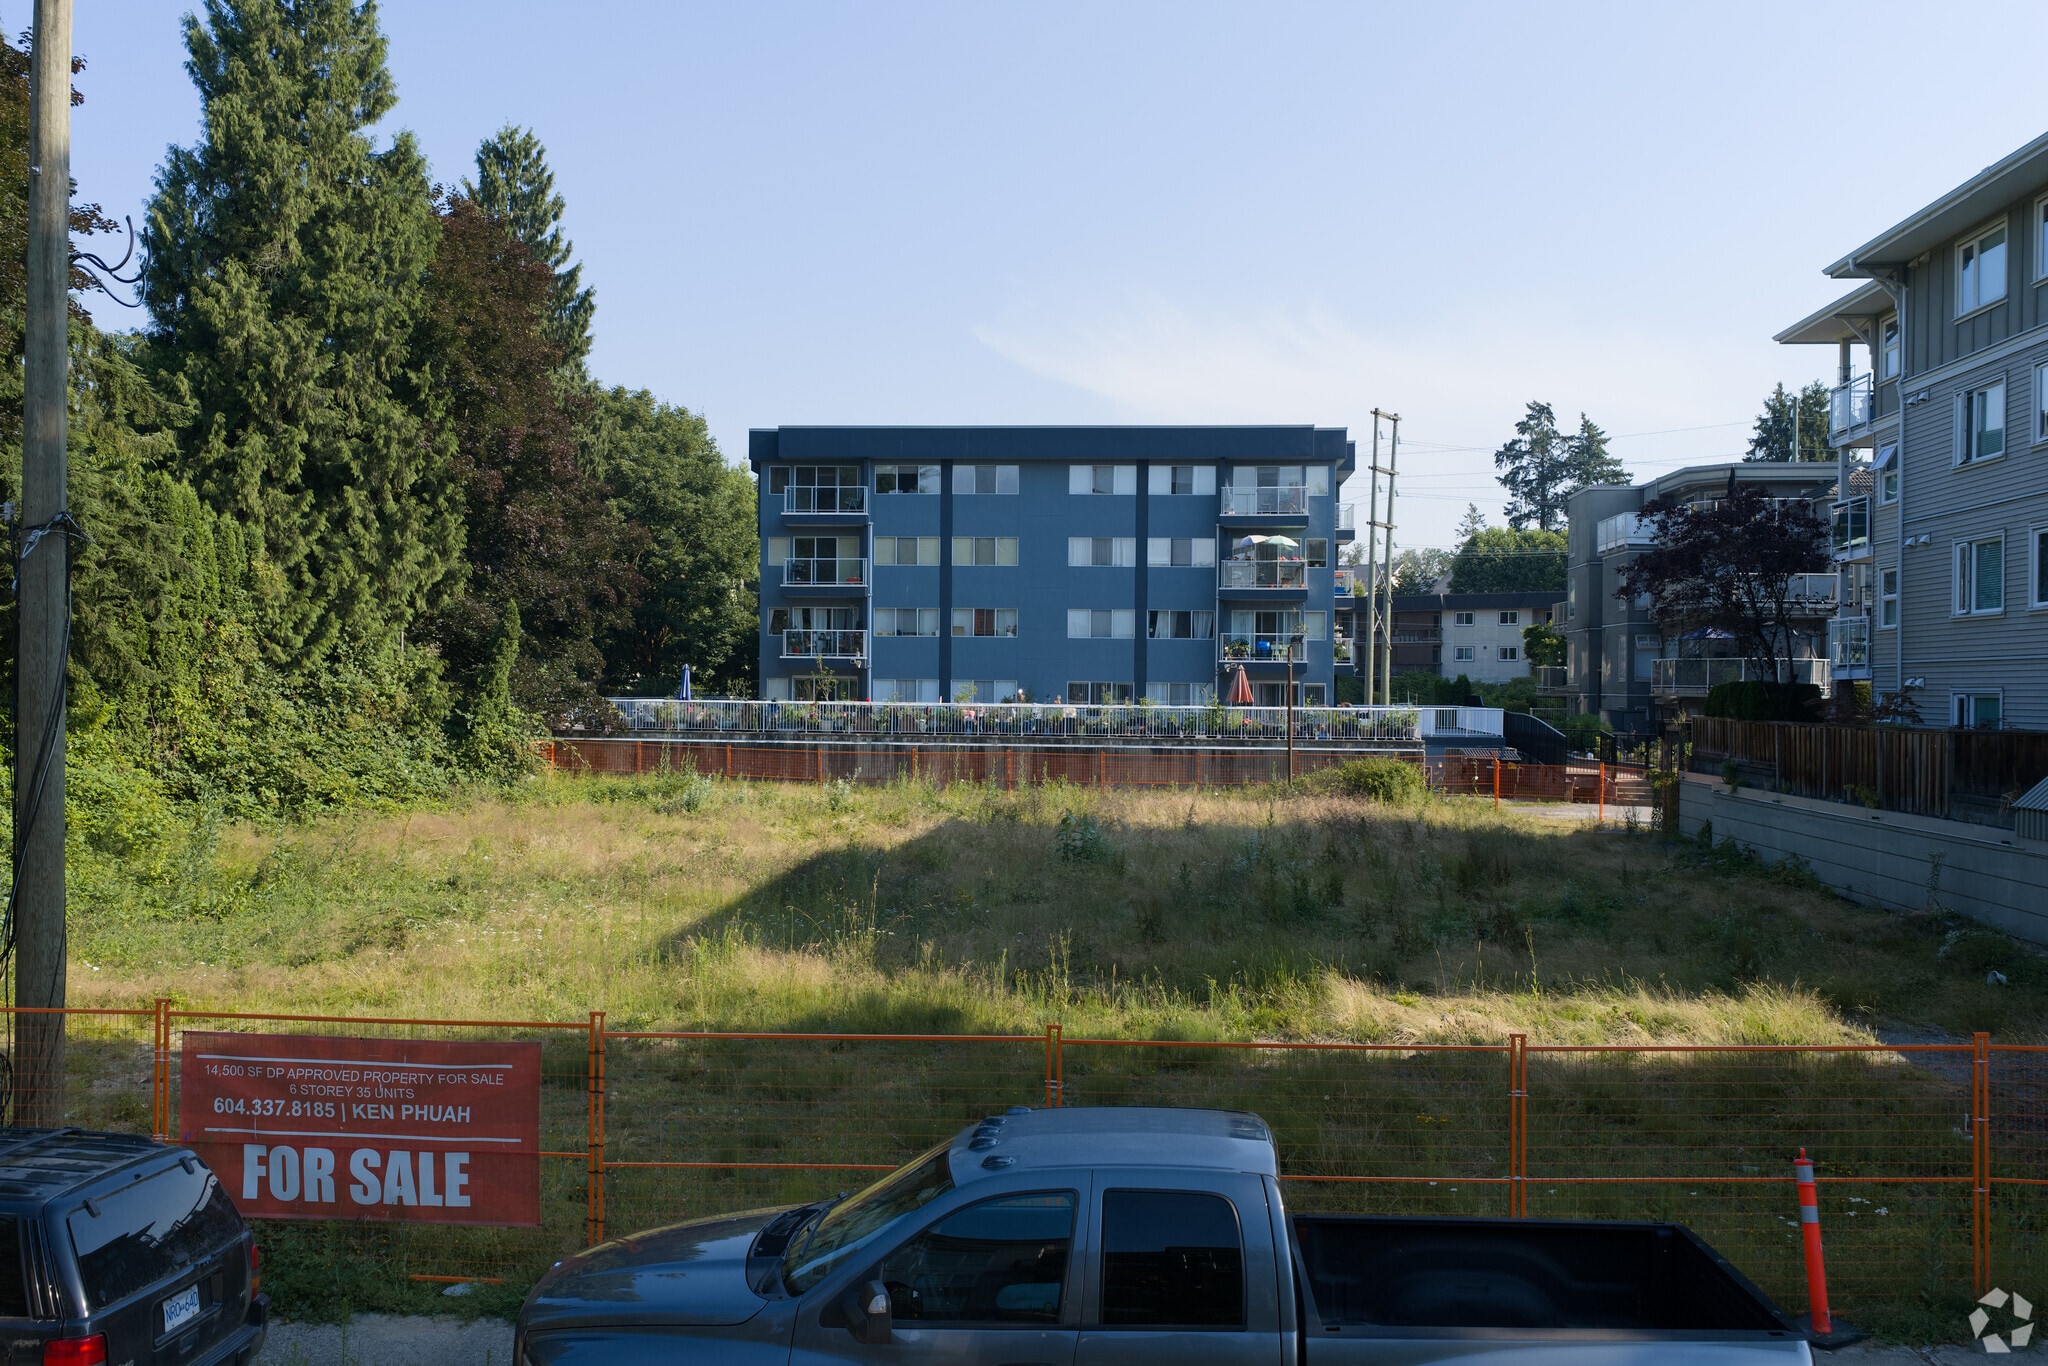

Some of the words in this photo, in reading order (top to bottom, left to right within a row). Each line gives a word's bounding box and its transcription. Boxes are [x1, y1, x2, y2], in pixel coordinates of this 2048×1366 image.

[205, 1064, 244, 1077] 14,500
[247, 1066, 264, 1077] SF
[266, 1067, 285, 1079] DP
[287, 1068, 360, 1083] APPROVED
[363, 1071, 434, 1085] PROPERTY
[438, 1073, 468, 1085] FOR
[471, 1073, 504, 1086] SALE
[289, 1084, 297, 1095] 6
[300, 1084, 352, 1097] STOREY
[356, 1086, 371, 1098] 35
[374, 1087, 415, 1099] UNITS
[213, 1097, 335, 1118] 604.337.8185
[352, 1104, 395, 1120] KEN
[401, 1104, 471, 1123] PHUAH
[242, 1143, 336, 1203] FOR
[349, 1148, 471, 1208] SALE
